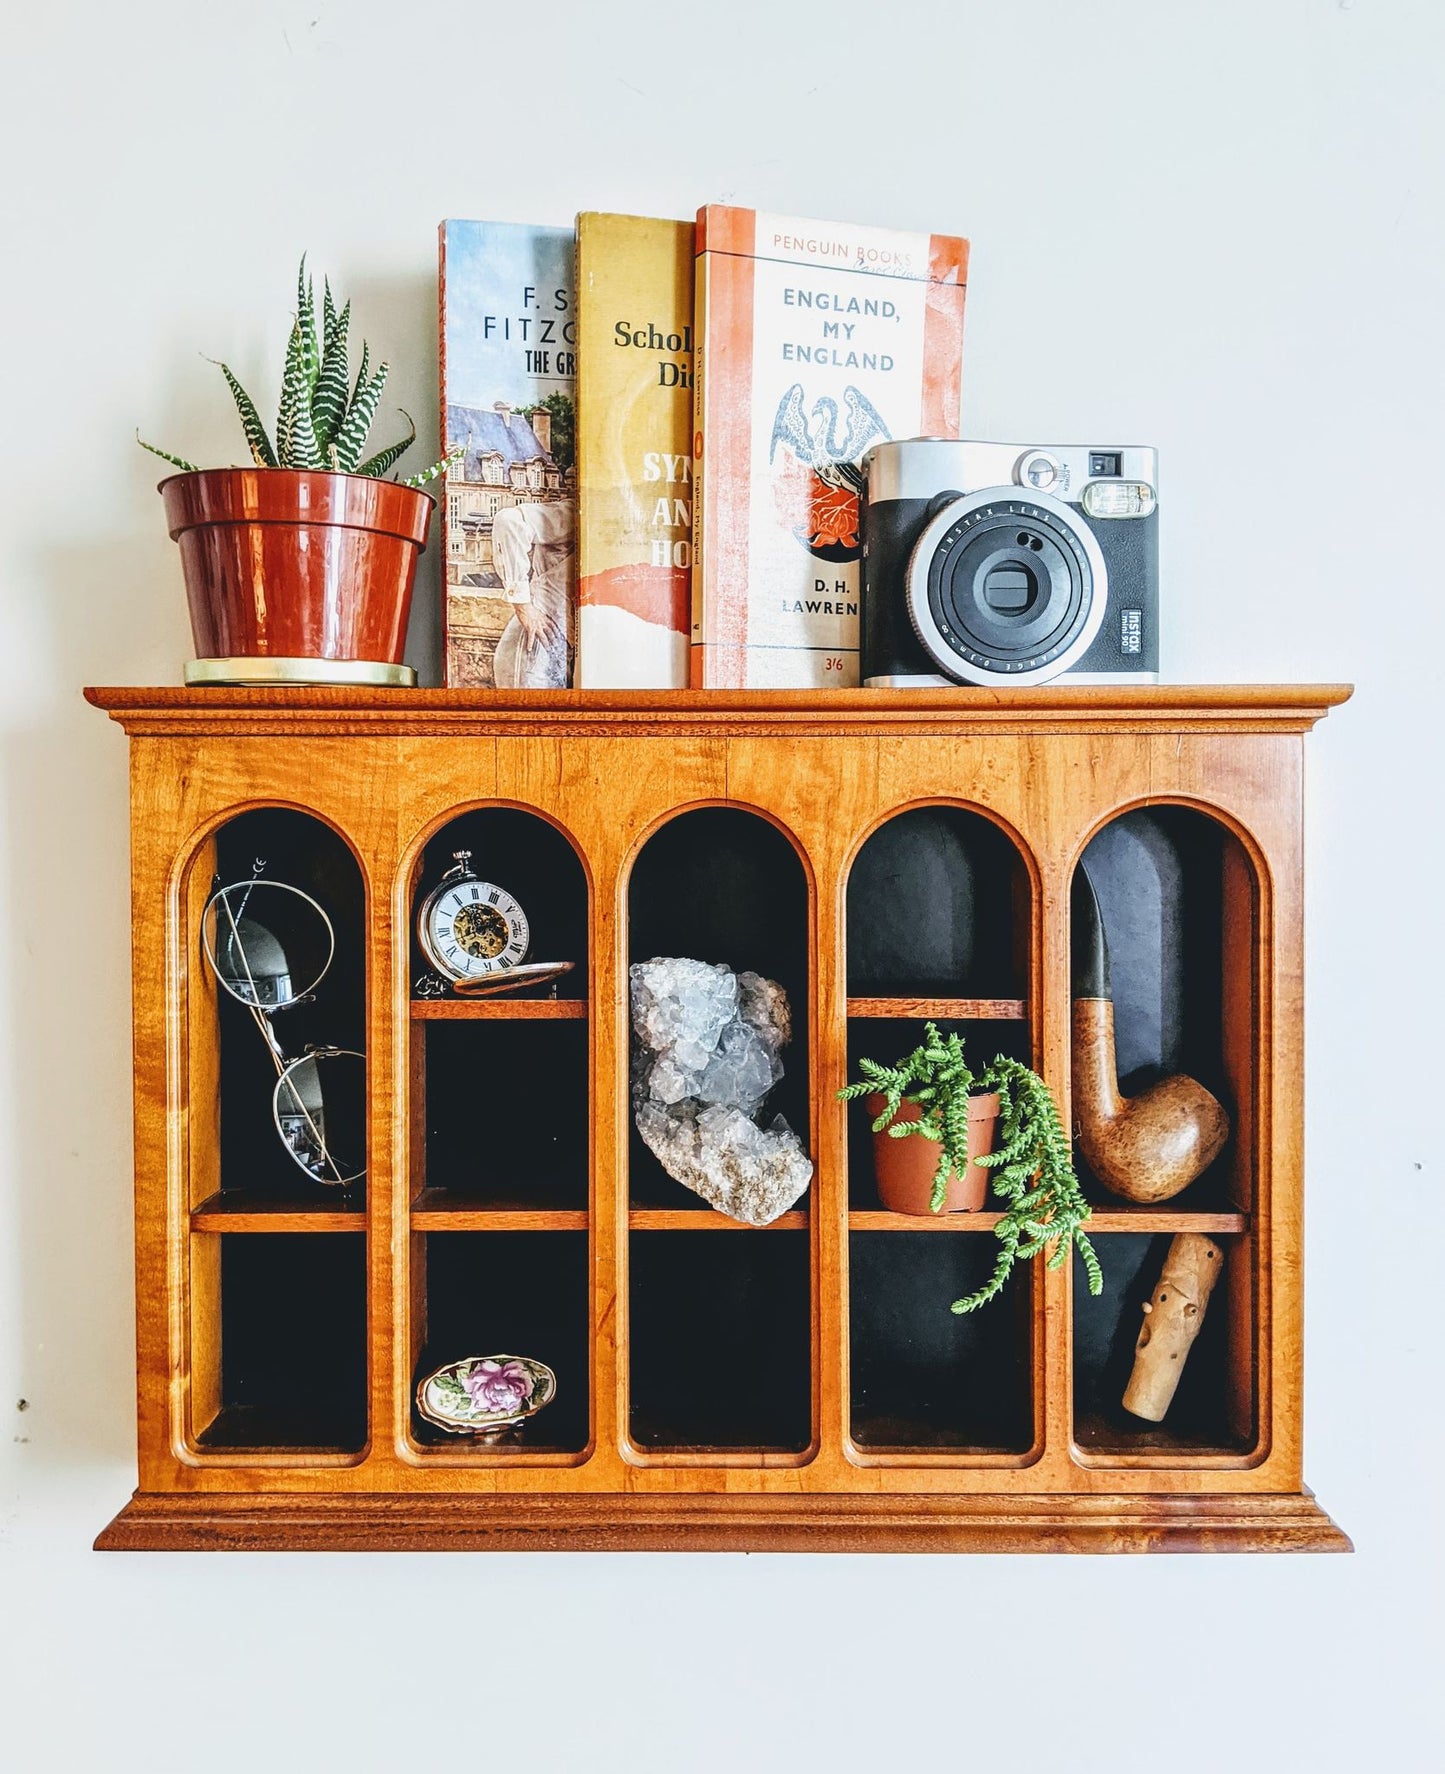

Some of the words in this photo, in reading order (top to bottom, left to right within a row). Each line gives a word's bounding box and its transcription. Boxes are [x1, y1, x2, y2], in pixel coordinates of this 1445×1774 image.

[774, 234, 849, 258] PENGUIN
[857, 247, 912, 267] BOOKS
[524, 287, 540, 309] F.
[783, 288, 900, 323] ENGLAND,
[614, 321, 692, 353] Schol
[823, 321, 856, 340] MY
[525, 350, 550, 374] THE
[556, 352, 575, 376] GR
[782, 343, 894, 371] ENGLAND
[941, 508, 993, 553] INSTAX
[1009, 505, 1050, 521] LENS
[650, 540, 692, 569] HO
[815, 579, 829, 592] D.
[835, 580, 850, 593] H.
[782, 600, 858, 615] LAWREN
[1121, 615, 1129, 634] mini
[1129, 611, 1142, 652] instax
[1121, 635, 1129, 647] 90
